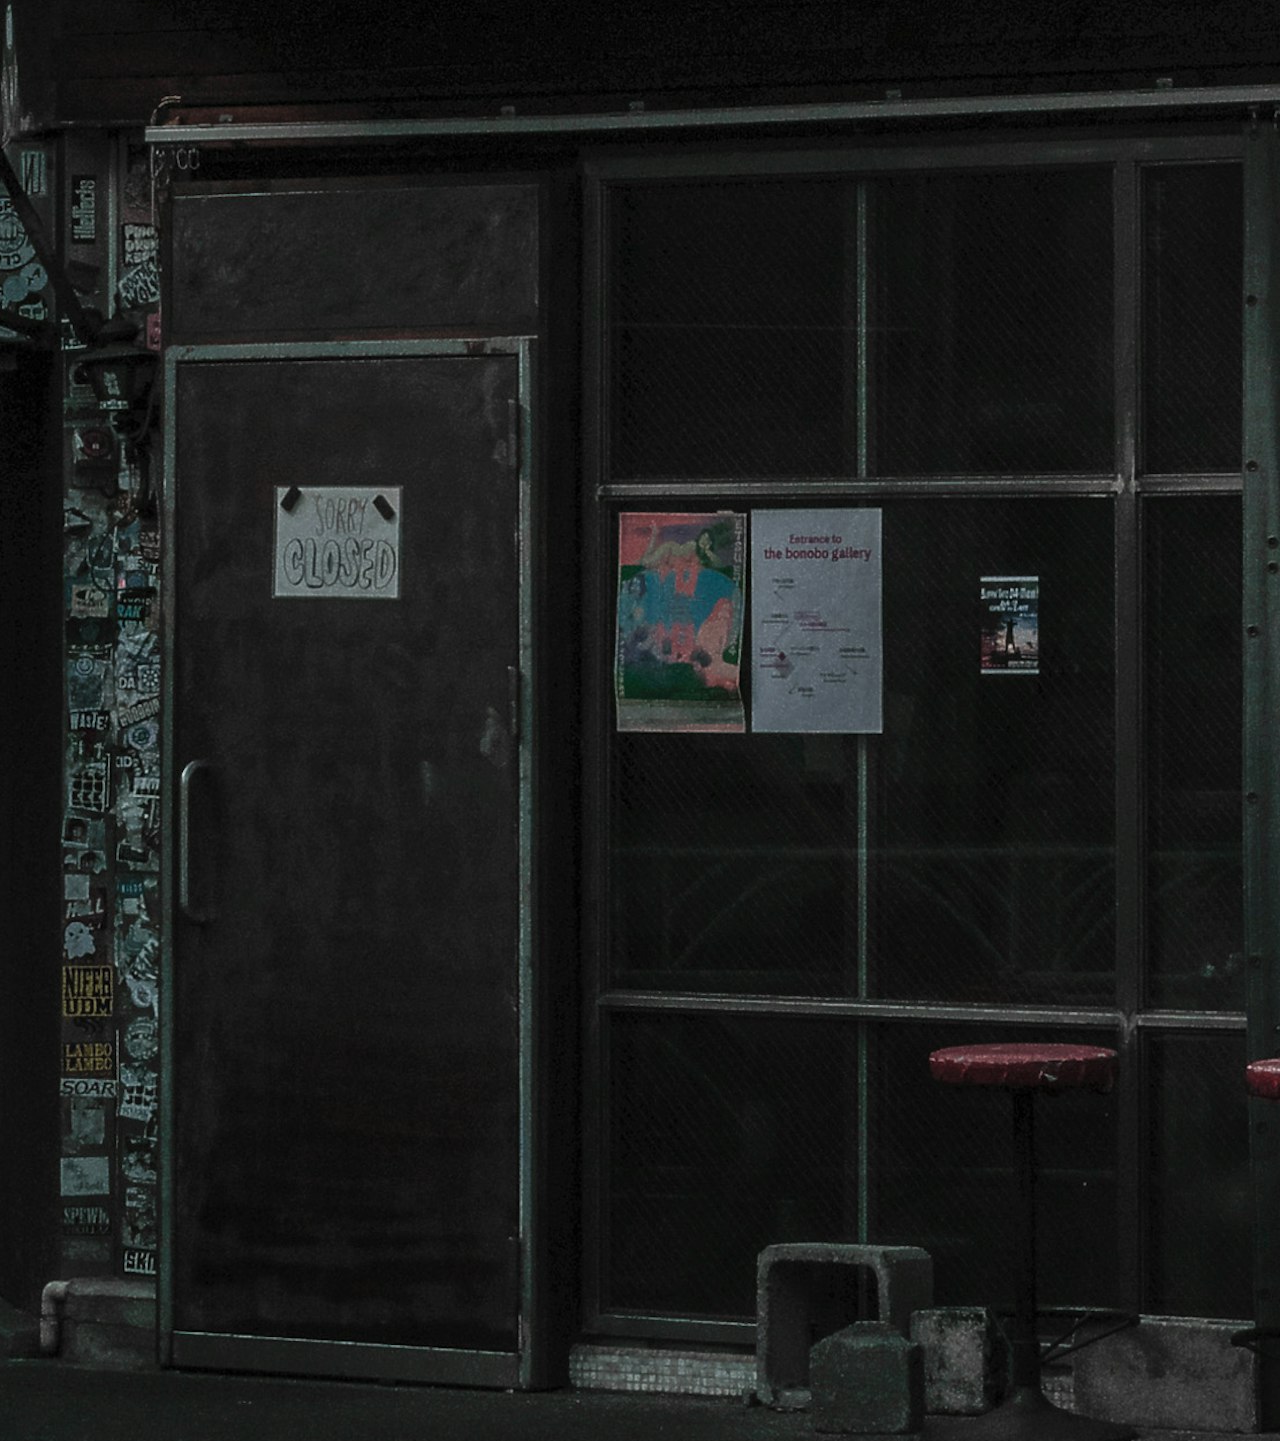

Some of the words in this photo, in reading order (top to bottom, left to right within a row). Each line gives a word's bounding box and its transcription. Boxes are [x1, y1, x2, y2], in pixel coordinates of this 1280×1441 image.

[313, 495, 369, 536] SORRY
[788, 534, 831, 545] Entrance
[832, 534, 843, 545] to
[283, 537, 396, 590] CLOSED
[764, 547, 782, 560] the
[785, 547, 829, 560] bonobo
[831, 547, 872, 562] gallery
[62, 1079, 116, 1098] SOAR
